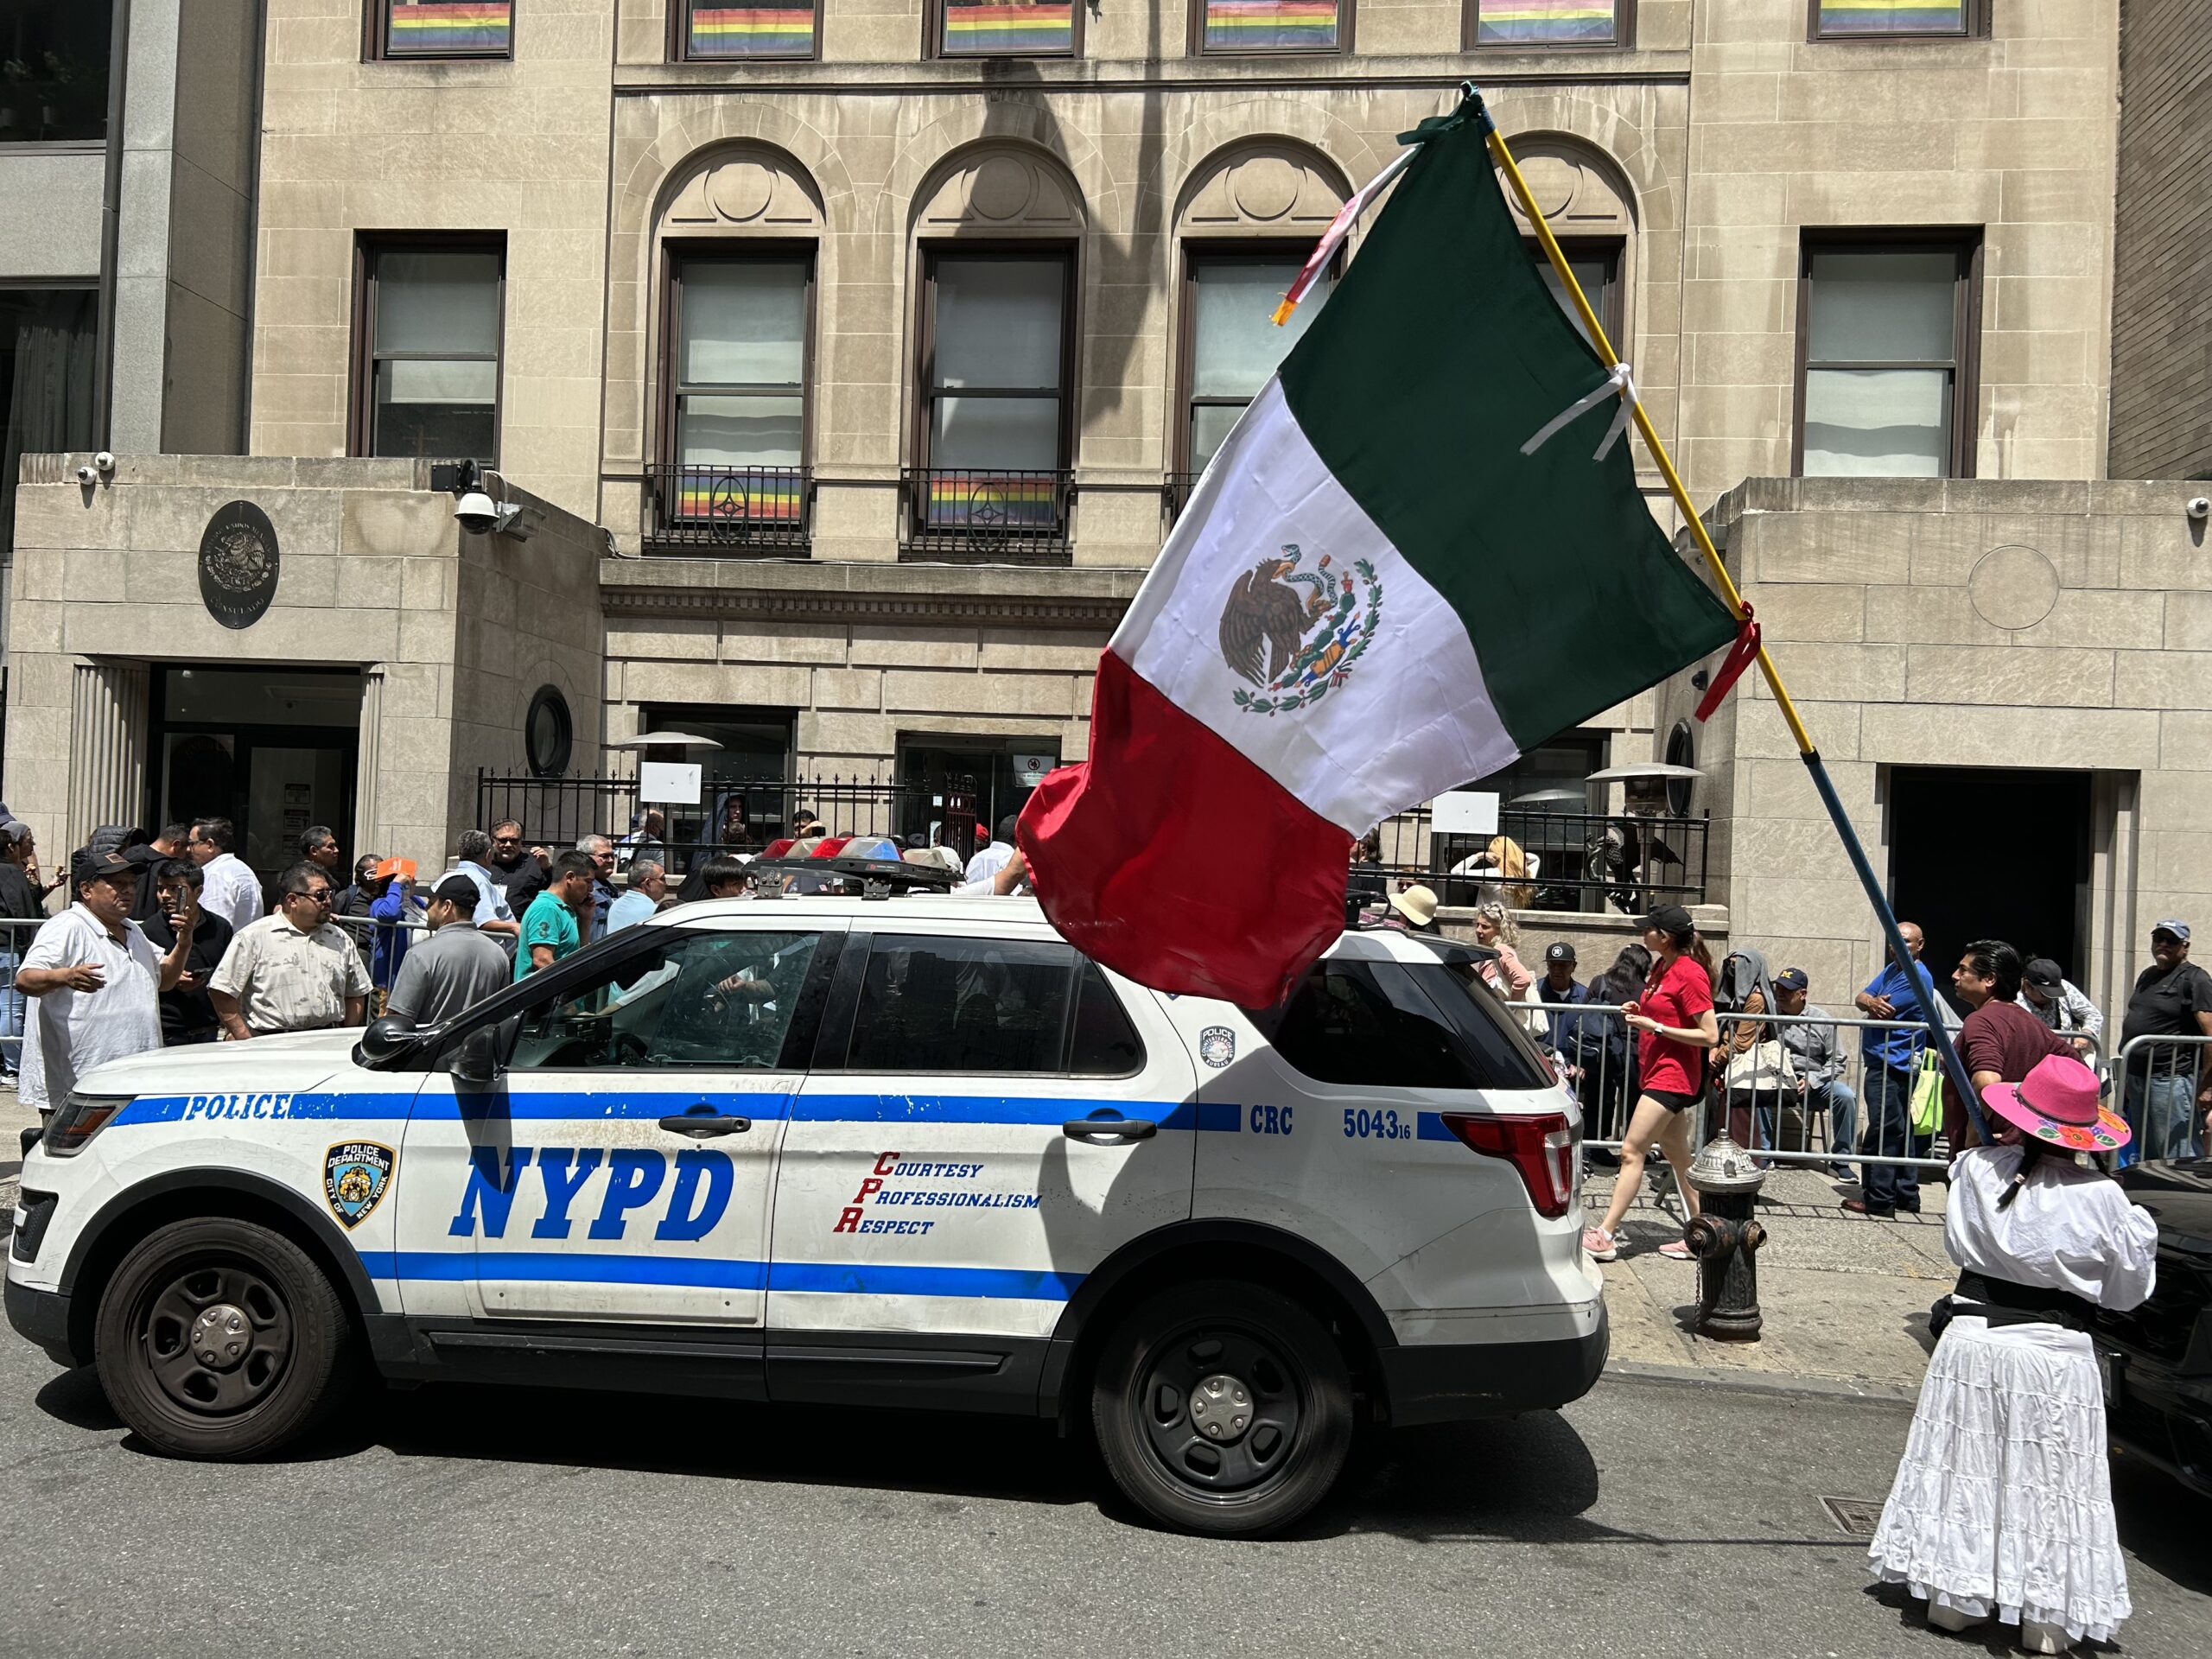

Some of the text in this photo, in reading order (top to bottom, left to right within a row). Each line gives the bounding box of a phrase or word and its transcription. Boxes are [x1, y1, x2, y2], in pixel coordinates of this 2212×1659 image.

[1202, 1027, 1233, 1041] POLICE
[185, 1094, 291, 1121] POLICE
[1250, 1104, 1293, 1135] CRC
[327, 1154, 390, 1171] DEPARTMENT
[343, 1144, 380, 1157] POLICE
[873, 1151, 984, 1178] COURTESY
[326, 1178, 344, 1214] CITY OF
[356, 1176, 389, 1219] NEW YORK
[448, 1146, 734, 1241] NYPD
[853, 1178, 1043, 1208] PROFESSIONALISM
[833, 1207, 935, 1235] RESPECT
